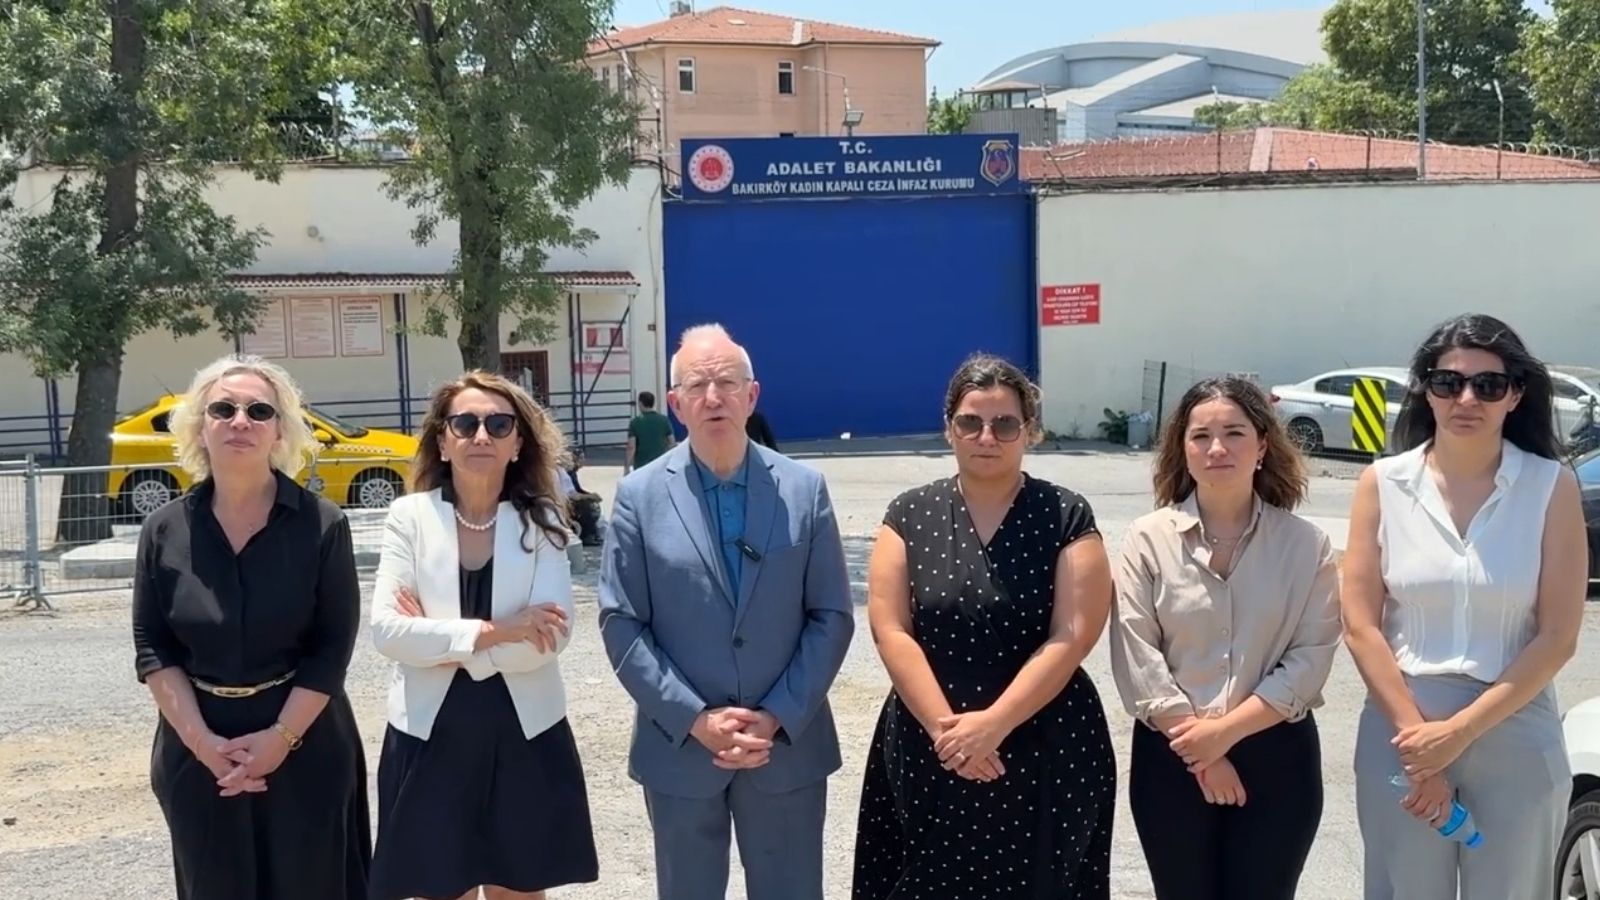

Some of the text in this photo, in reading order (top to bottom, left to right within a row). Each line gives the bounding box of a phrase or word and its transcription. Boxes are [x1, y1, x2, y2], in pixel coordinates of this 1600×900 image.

[838, 141, 872, 154] T.C.
[766, 156, 942, 176] ADALET BAKANLIĞI
[732, 177, 975, 195] BAKIRKÖY KADIN KAPALI CEZA İNFAZ KURUMU
